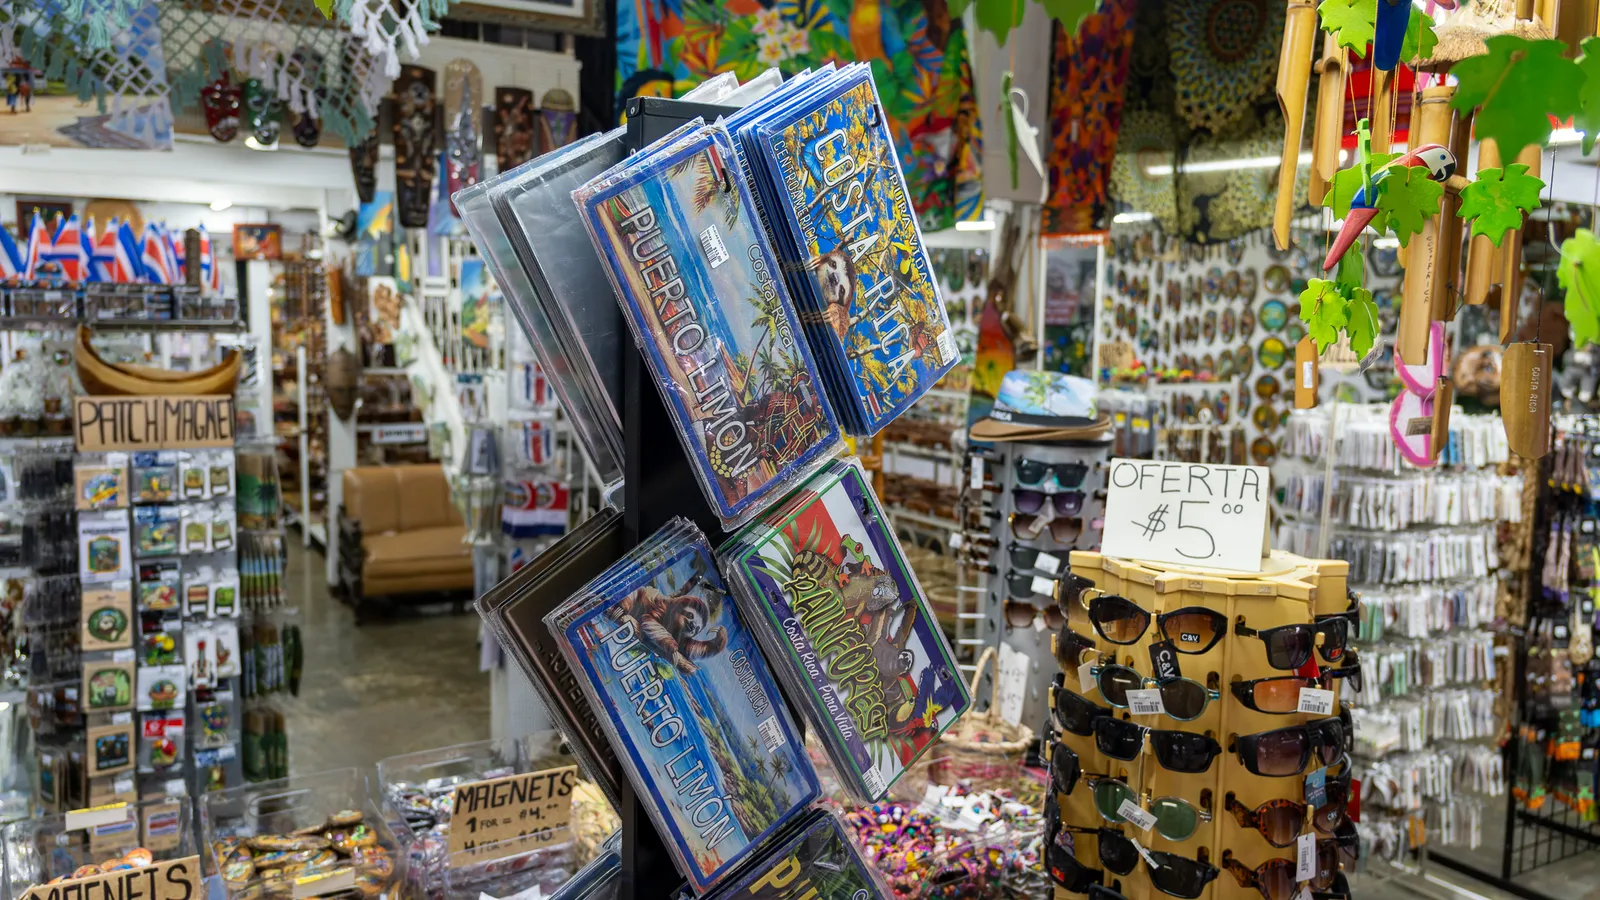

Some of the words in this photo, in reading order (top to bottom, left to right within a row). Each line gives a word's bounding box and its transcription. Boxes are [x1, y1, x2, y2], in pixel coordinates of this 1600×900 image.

[774, 139, 818, 247] CENTROAMERICA
[889, 174, 912, 233] PURA
[908, 235, 928, 284] VIDA
[747, 244, 776, 303] Costa
[773, 306, 794, 349] Rica
[815, 128, 880, 264] COSTA
[863, 275, 915, 382] RICA
[620, 205, 706, 357] PUERTO
[689, 357, 759, 479] LIMÓN
[1530, 366, 1541, 390] COSTA
[78, 399, 159, 446] PATCH
[1529, 393, 1538, 413] RICA
[1112, 463, 1260, 501] OFERTA
[782, 618, 804, 653] Costa
[800, 650, 817, 681] Rica
[817, 684, 839, 715] Pura
[832, 710, 852, 741] Vida
[783, 573, 887, 738] RAINFOREST
[1181, 633, 1199, 642] C&V
[728, 648, 753, 689] COSTA
[746, 685, 768, 718] RICA
[598, 619, 683, 749] PUERTO
[664, 748, 736, 851] LIMÓN
[454, 770, 575, 815] MAGNETS
[465, 817, 477, 833] 1
[480, 818, 499, 830] FOR
